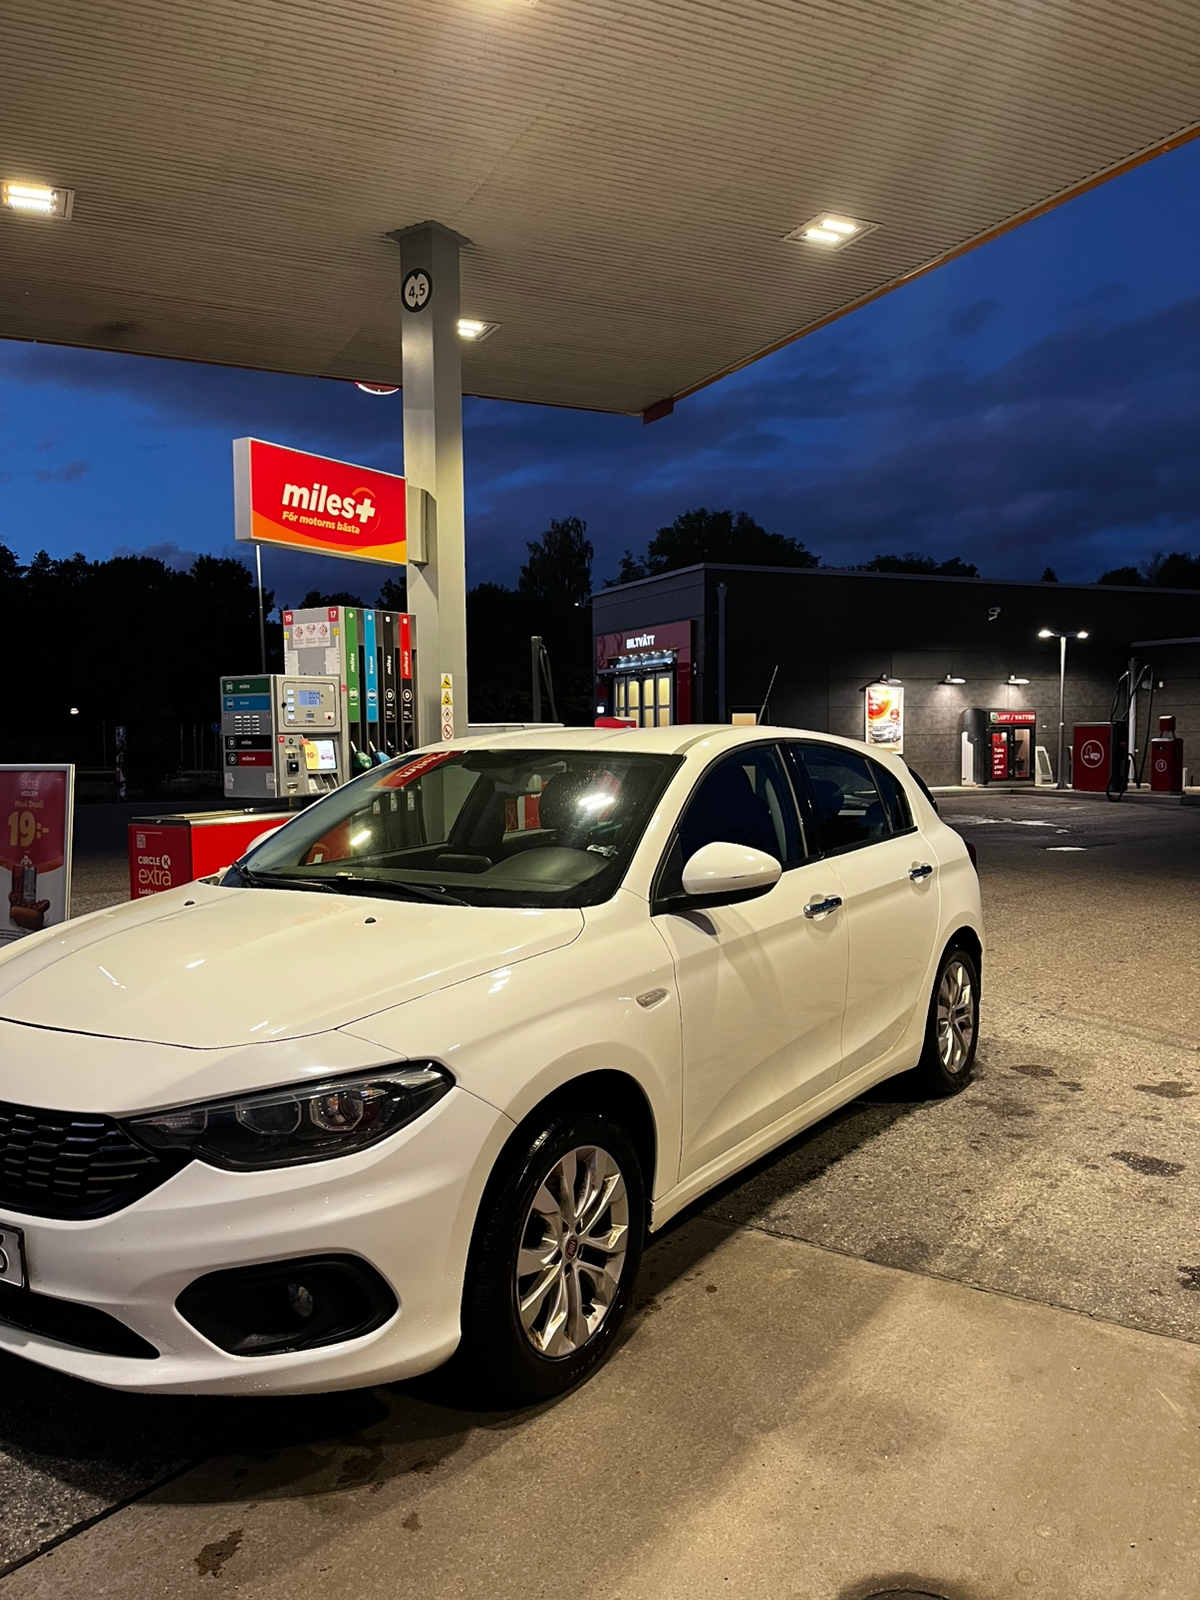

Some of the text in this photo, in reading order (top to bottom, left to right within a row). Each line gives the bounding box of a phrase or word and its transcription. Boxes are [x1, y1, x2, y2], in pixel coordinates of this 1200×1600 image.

[408, 283, 426, 299] 4,5
[282, 511, 360, 535] För motorns bästa
[626, 633, 655, 649] BILTVÅTT
[20, 778, 39, 790] extra
[138, 856, 160, 866] CIRCLE
[138, 866, 172, 887] extra
